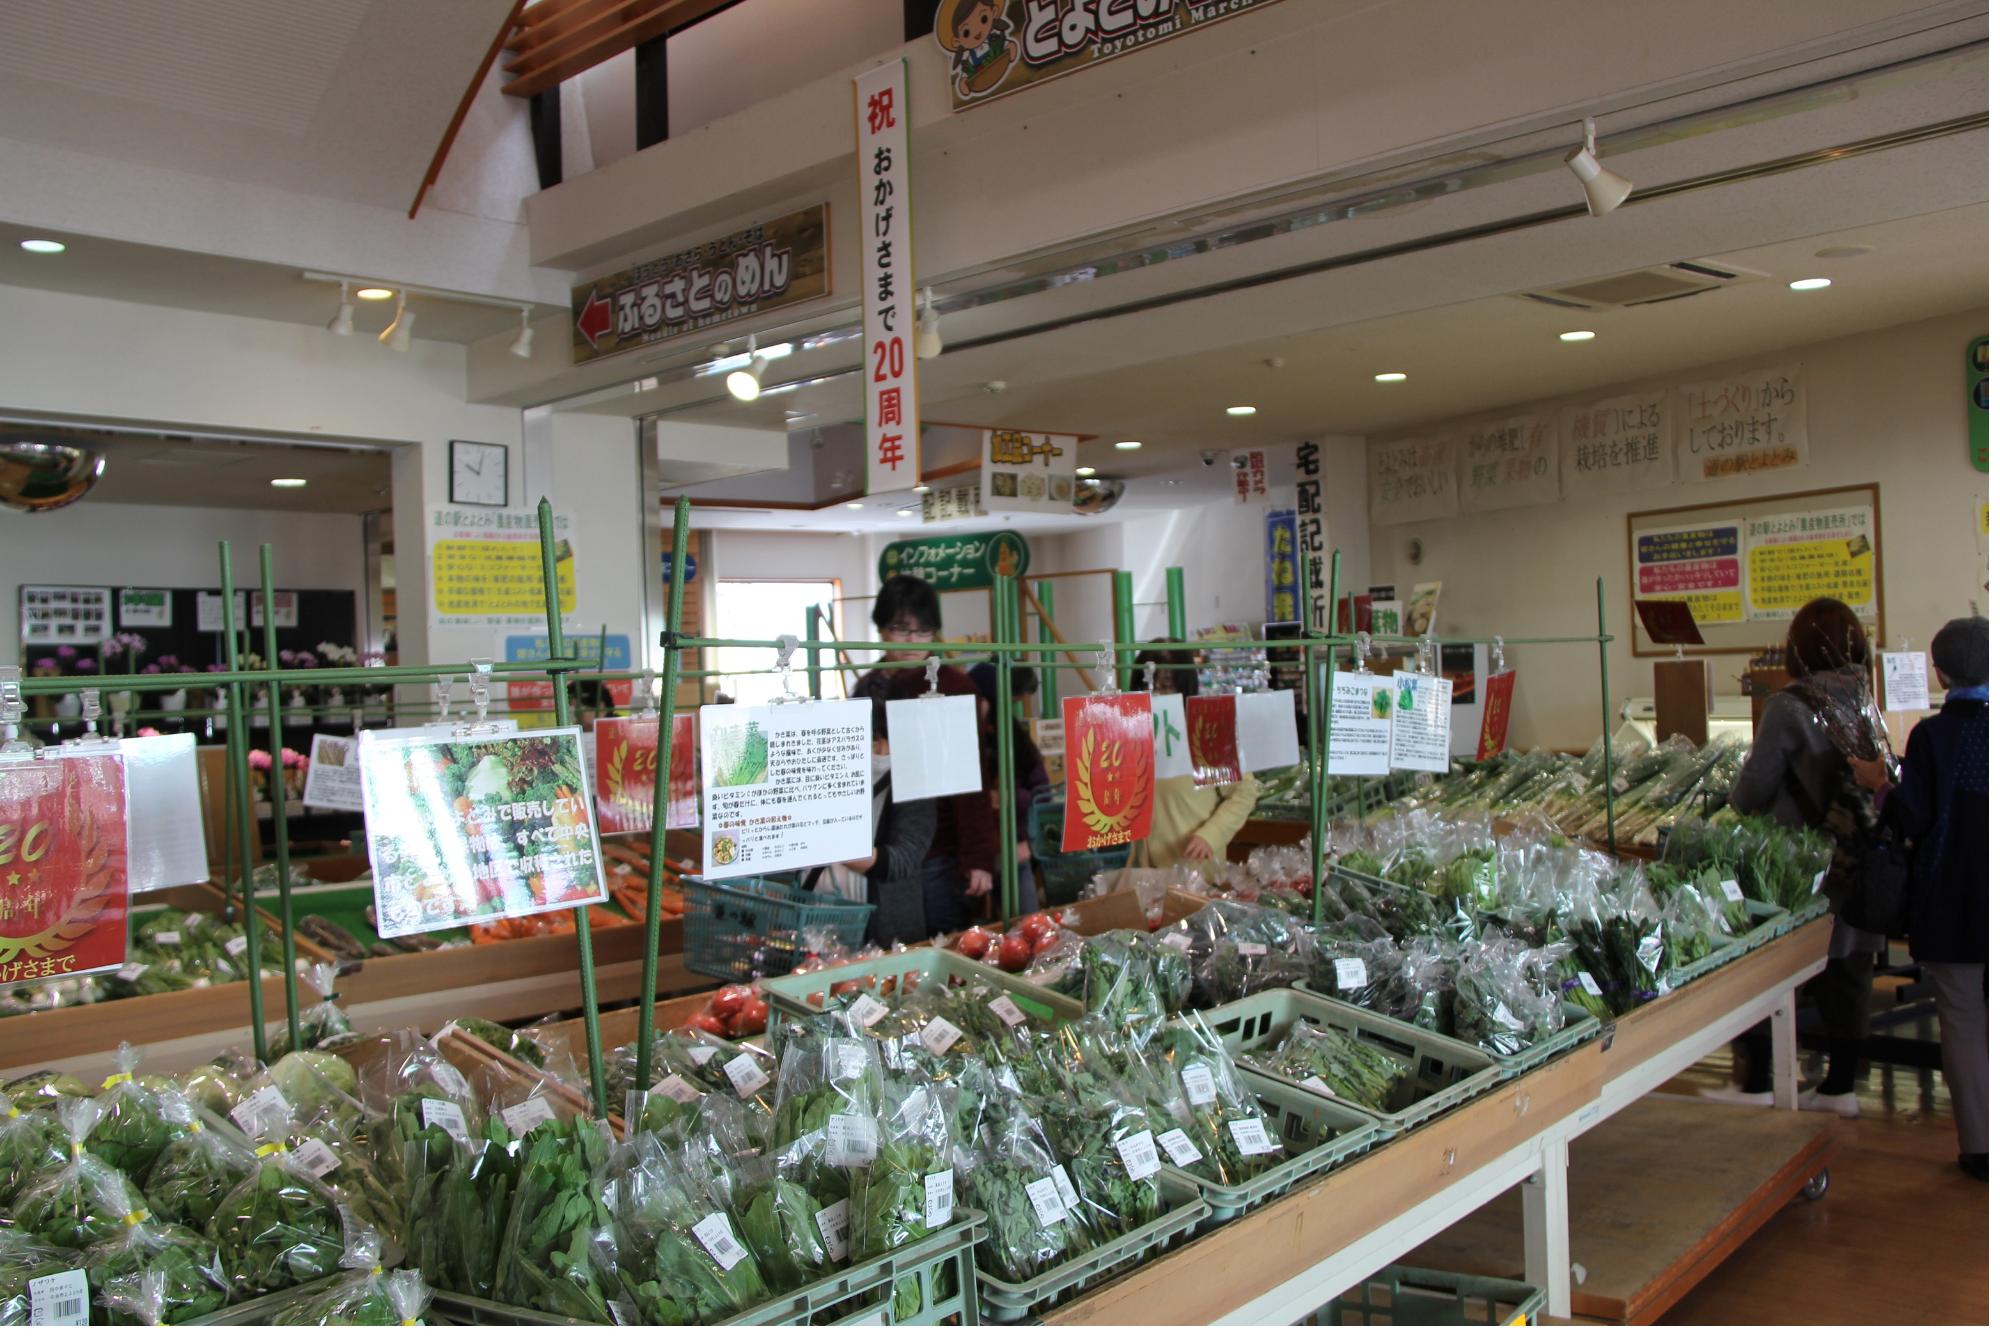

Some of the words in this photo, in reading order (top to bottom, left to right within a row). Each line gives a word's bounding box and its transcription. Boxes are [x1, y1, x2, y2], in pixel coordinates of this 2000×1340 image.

[1091, 15, 1181, 58] Toyotomi
[867, 86, 896, 135] 祝
[873, 146, 896, 332] おかげさまで
[616, 241, 791, 335] ふるさとのめん
[873, 336, 904, 472] 20周年
[1576, 432, 1660, 473] 栽培を推進
[1690, 413, 1785, 454] しております。
[899, 541, 988, 564] インフォメーション
[1087, 829, 1132, 849] おかげさまで
[0, 953, 76, 982] げさまで
